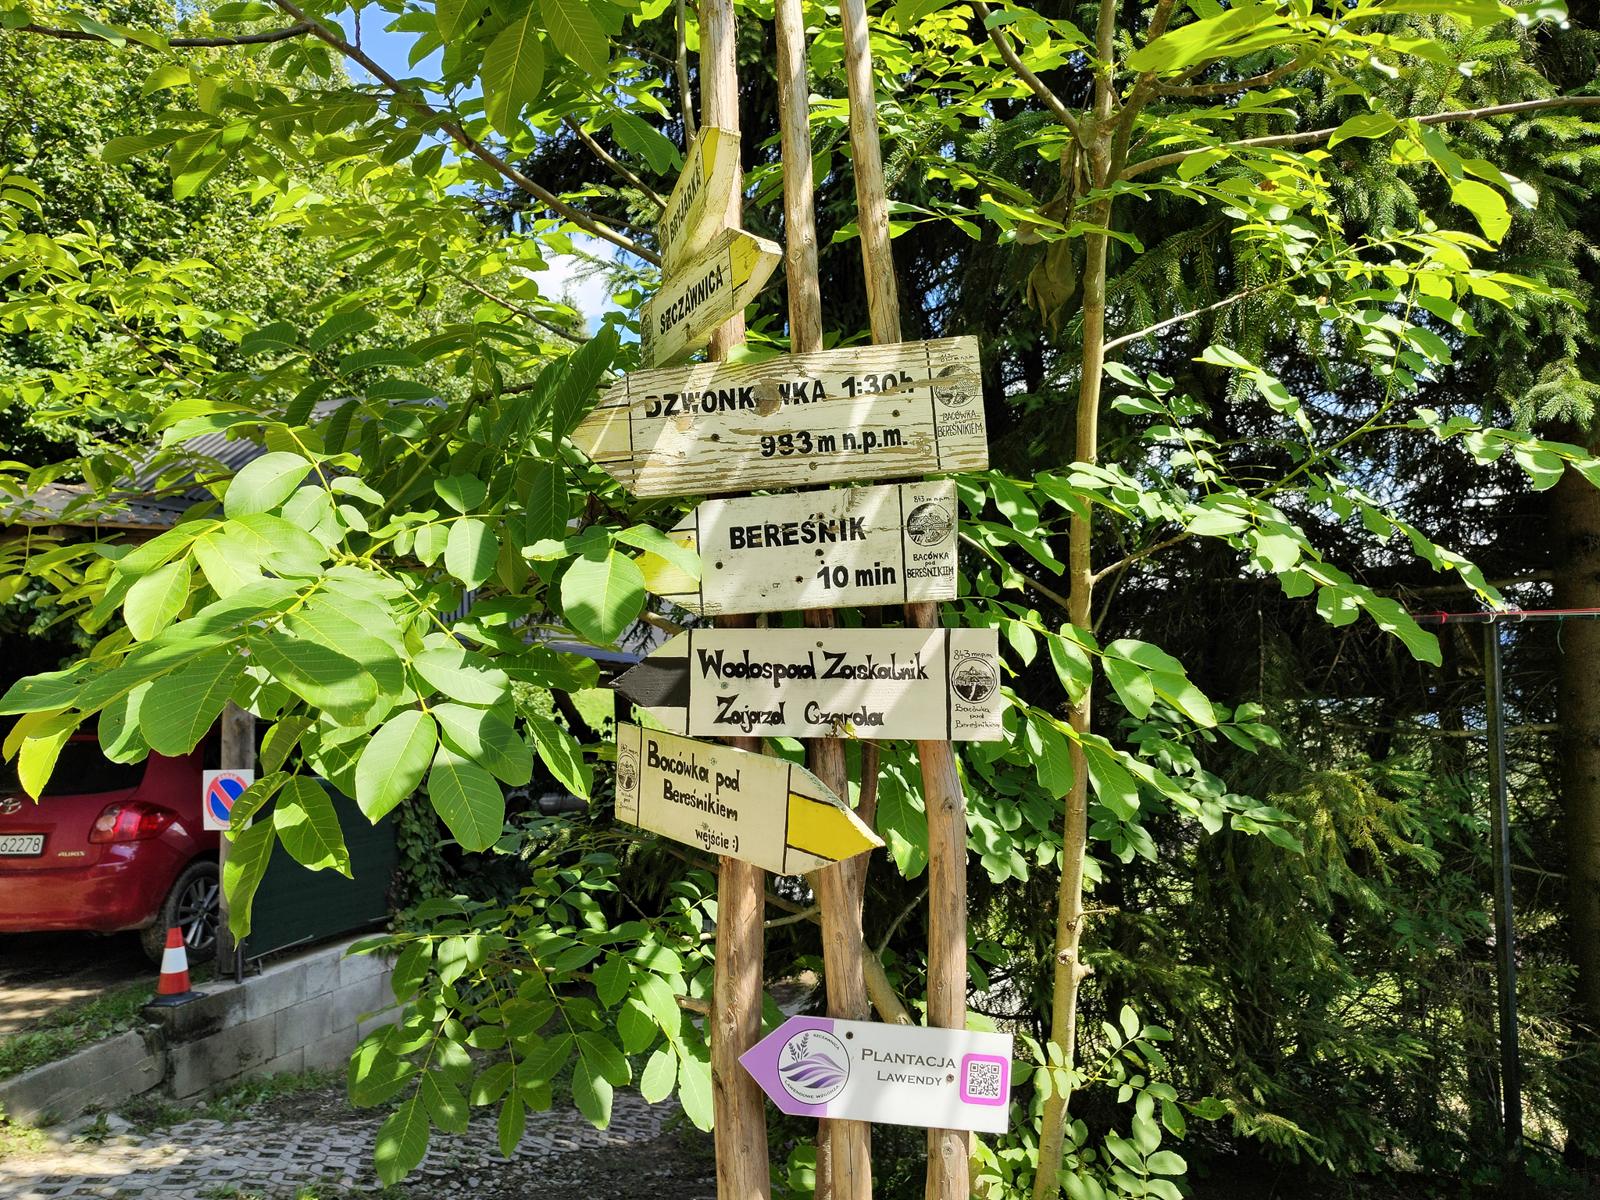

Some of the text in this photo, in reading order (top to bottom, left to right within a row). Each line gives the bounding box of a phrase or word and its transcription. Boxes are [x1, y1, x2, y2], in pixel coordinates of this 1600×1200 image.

[660, 264, 724, 336] SZCZAWNICA
[644, 370, 914, 418] DZWONKWKA 1:30h
[760, 430, 813, 457] 983
[817, 434, 836, 452] m
[729, 513, 867, 550] BEREŚNIK
[912, 551, 950, 562] BACÓWKA
[816, 562, 896, 590] 10 min
[696, 648, 929, 689] Wodospad Zaskalnik
[713, 694, 885, 733] Zajazd Czarda
[647, 739, 741, 795] Bacówka pod
[662, 778, 739, 822] Bereśnikiem
[0, 837, 42, 852] 62278
[695, 827, 730, 851] wejście
